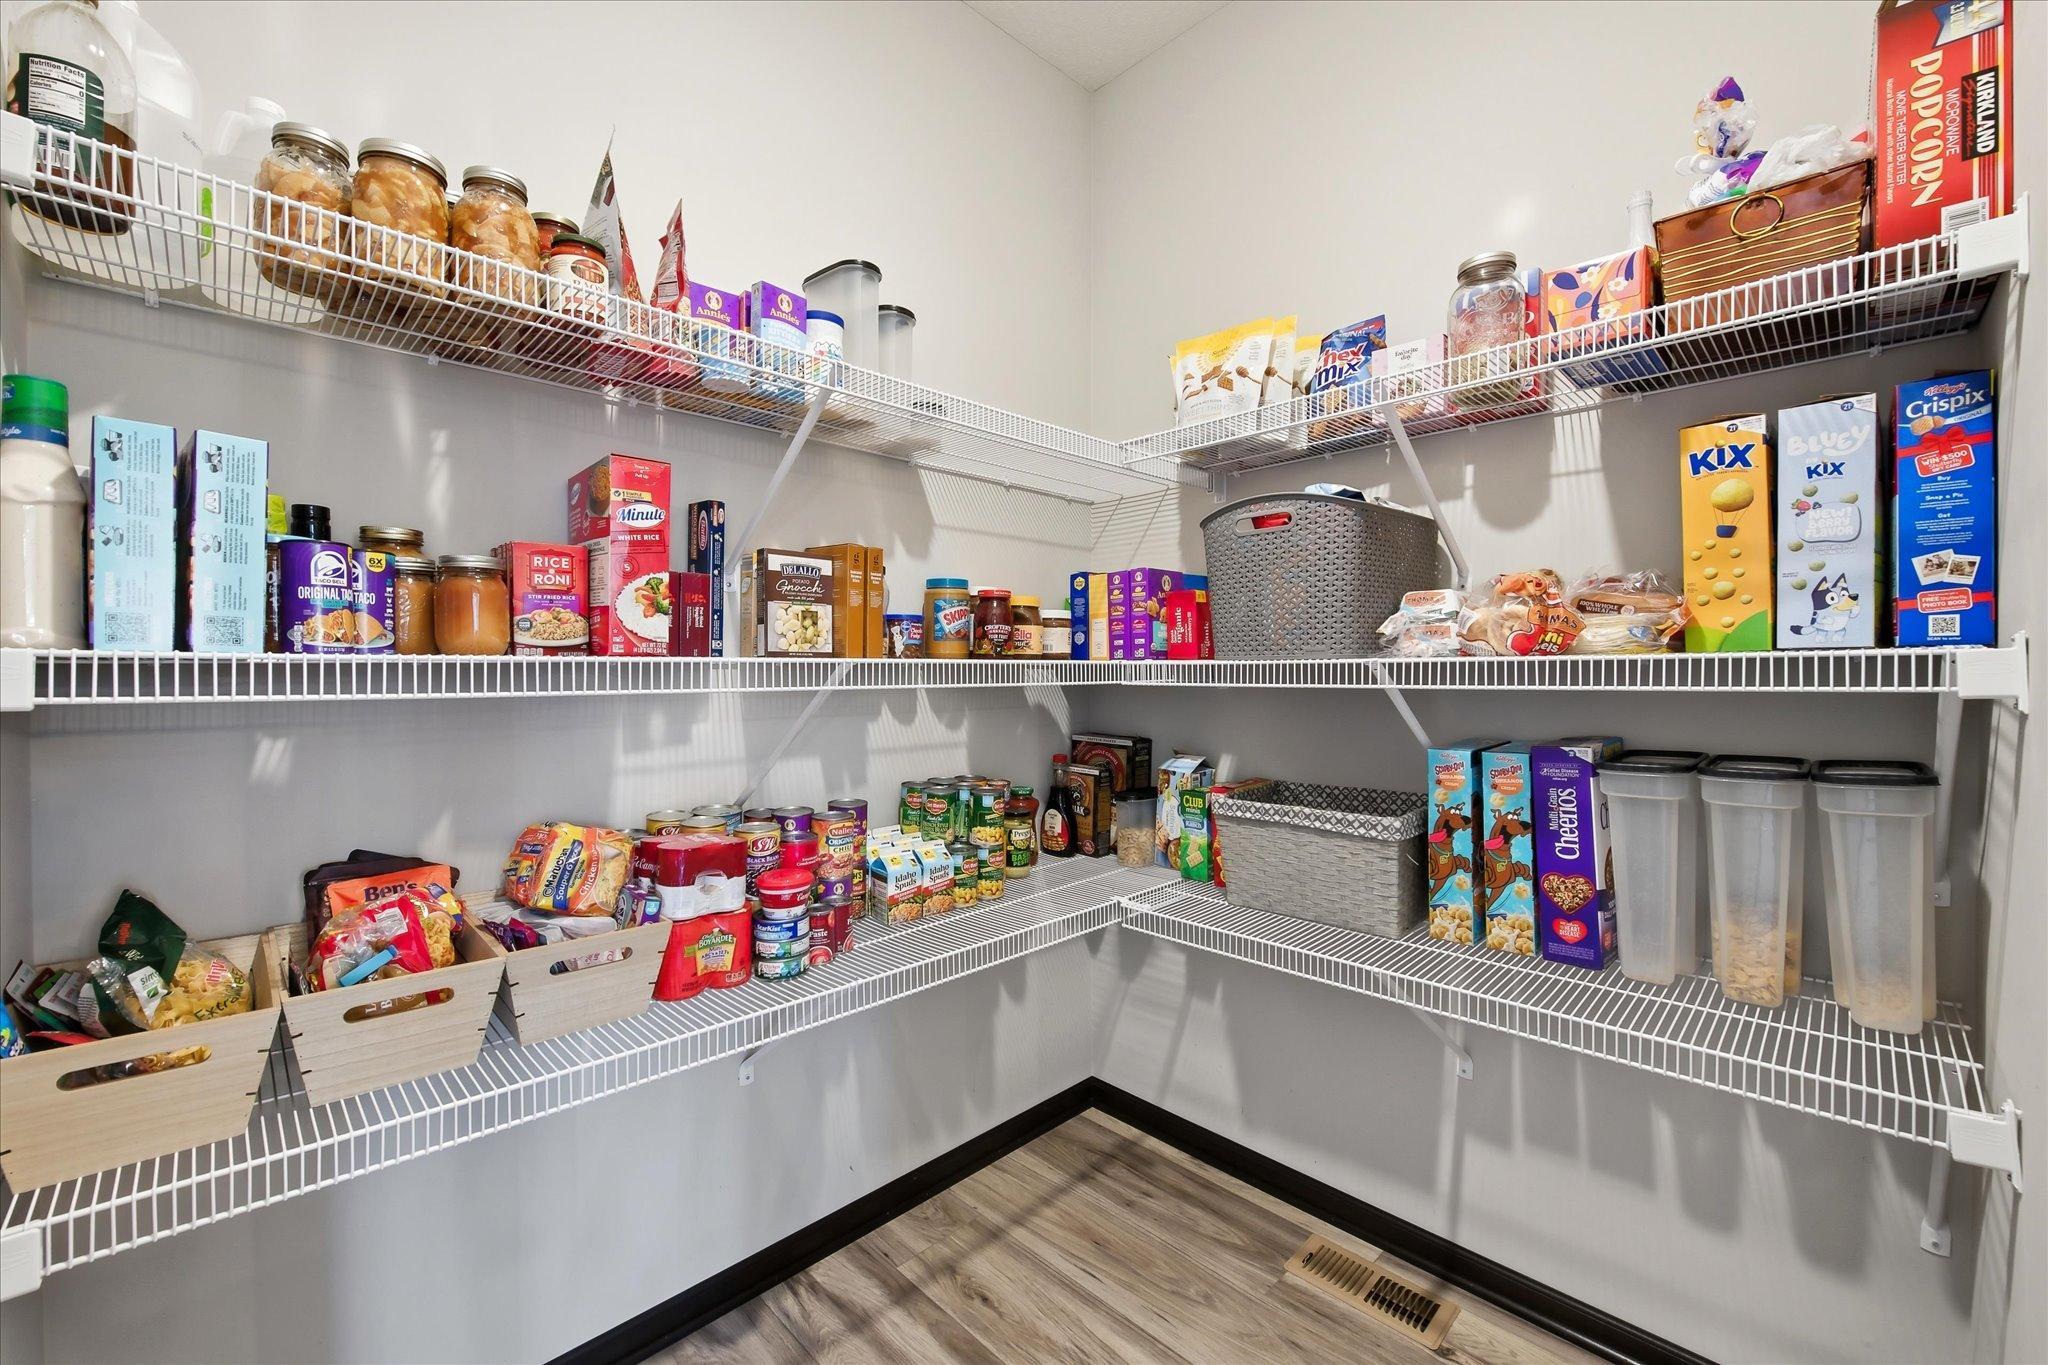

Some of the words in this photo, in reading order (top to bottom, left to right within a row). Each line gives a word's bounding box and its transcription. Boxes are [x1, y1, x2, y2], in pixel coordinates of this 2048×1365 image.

[30, 59, 62, 70] Nutrition
[64, 66, 85, 79] Facts
[1886, 78, 1895, 98] Natural
[1896, 90, 1907, 118] MOVIE
[1976, 71, 1996, 153] KIRKLAND
[1945, 88, 1961, 157] MICROWAVE
[1961, 78, 1977, 151] Signature
[1896, 118, 1907, 155] THEATER
[1910, 50, 1944, 208] POPCORN
[1896, 155, 1907, 186] BUTTER
[696, 306, 731, 323] Annie's
[769, 307, 800, 326] Annie's
[1317, 341, 1368, 371] hex
[1395, 347, 1419, 357] favorite
[1317, 361, 1363, 388] mix
[1905, 388, 1985, 418] Crispix
[1786, 424, 1872, 457] BLUEY
[1688, 443, 1755, 478] KIX
[1806, 461, 1846, 480] KIX
[617, 507, 666, 522] Minute
[1808, 506, 1852, 519] NEW!
[1805, 526, 1854, 538] FLAVOR
[1808, 517, 1850, 529] BERRY
[699, 518, 707, 548] Barilla
[368, 557, 383, 565] 6X
[533, 556, 570, 569] RICE
[533, 573, 570, 586] RONI
[783, 565, 819, 577] DELALLO
[298, 586, 340, 599] ORIGINAL
[776, 579, 826, 594] Gnocchi
[353, 592, 376, 605] TACO
[1595, 602, 1619, 610] WHOLE
[1585, 605, 1609, 614] WHEAT
[1175, 607, 1185, 643] organic
[1013, 629, 1033, 640] ella
[1183, 795, 1204, 808] CLUB
[1548, 787, 1558, 808] Grain
[1549, 811, 1559, 831] Multi
[1554, 787, 1580, 861] Cheerios
[753, 836, 776, 852] S&W
[544, 848, 570, 888] Maruchan
[746, 856, 766, 864] BLACK
[579, 861, 598, 895] Chicken
[895, 871, 917, 883] Idaho
[929, 864, 950, 876] Idaho
[929, 871, 950, 883] Spuds
[364, 880, 418, 901] Ben's
[555, 873, 571, 901] Souper
[566, 863, 573, 871] 6
[894, 878, 917, 891] Spuds
[756, 924, 781, 932] StarKist
[809, 930, 828, 938] Paste
[698, 934, 734, 949] BOYARDEE
[193, 993, 241, 1020] Extra
